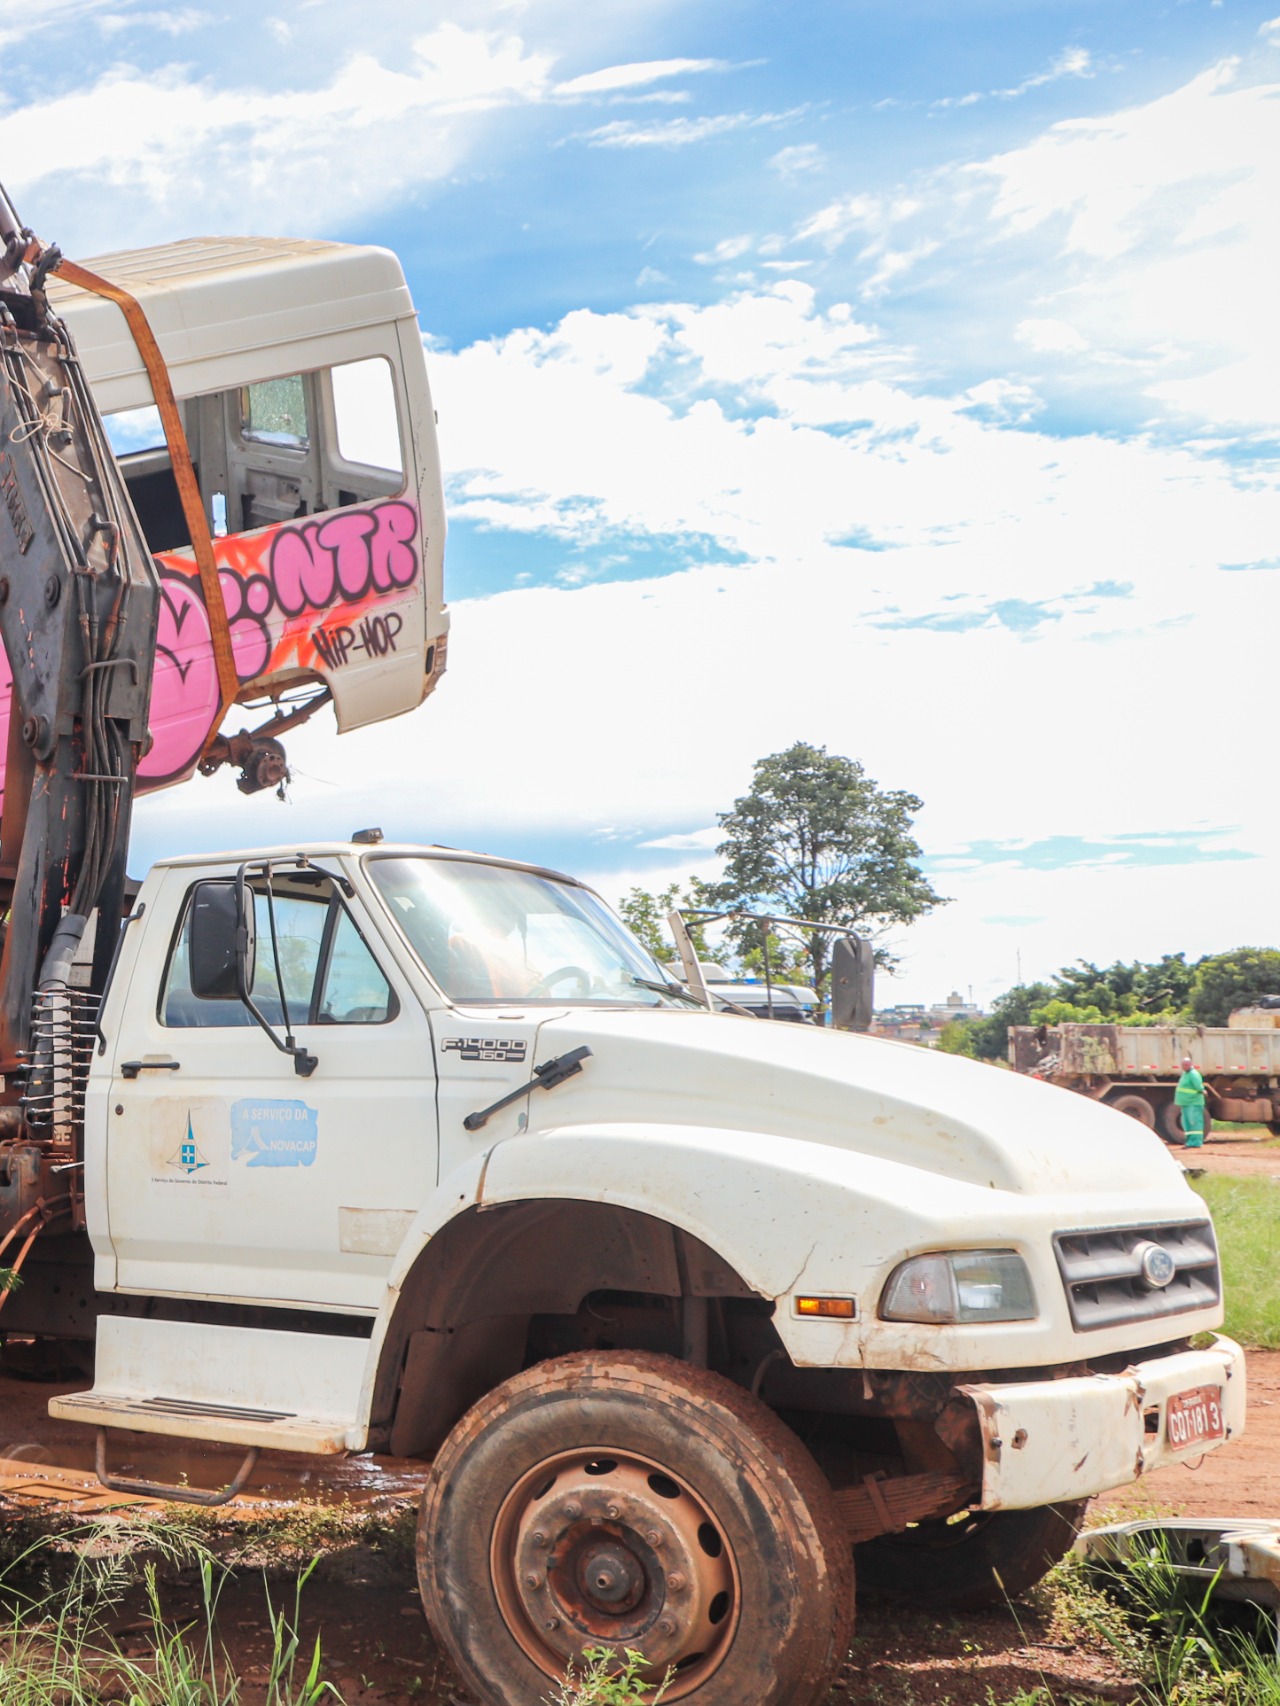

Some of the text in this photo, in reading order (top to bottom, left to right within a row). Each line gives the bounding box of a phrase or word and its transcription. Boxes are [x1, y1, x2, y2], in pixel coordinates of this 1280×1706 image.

[478, 1050, 506, 1060] 160
[243, 1108, 308, 1123] A SERVIÇO DA
[270, 1140, 315, 1152] NOVACAP
